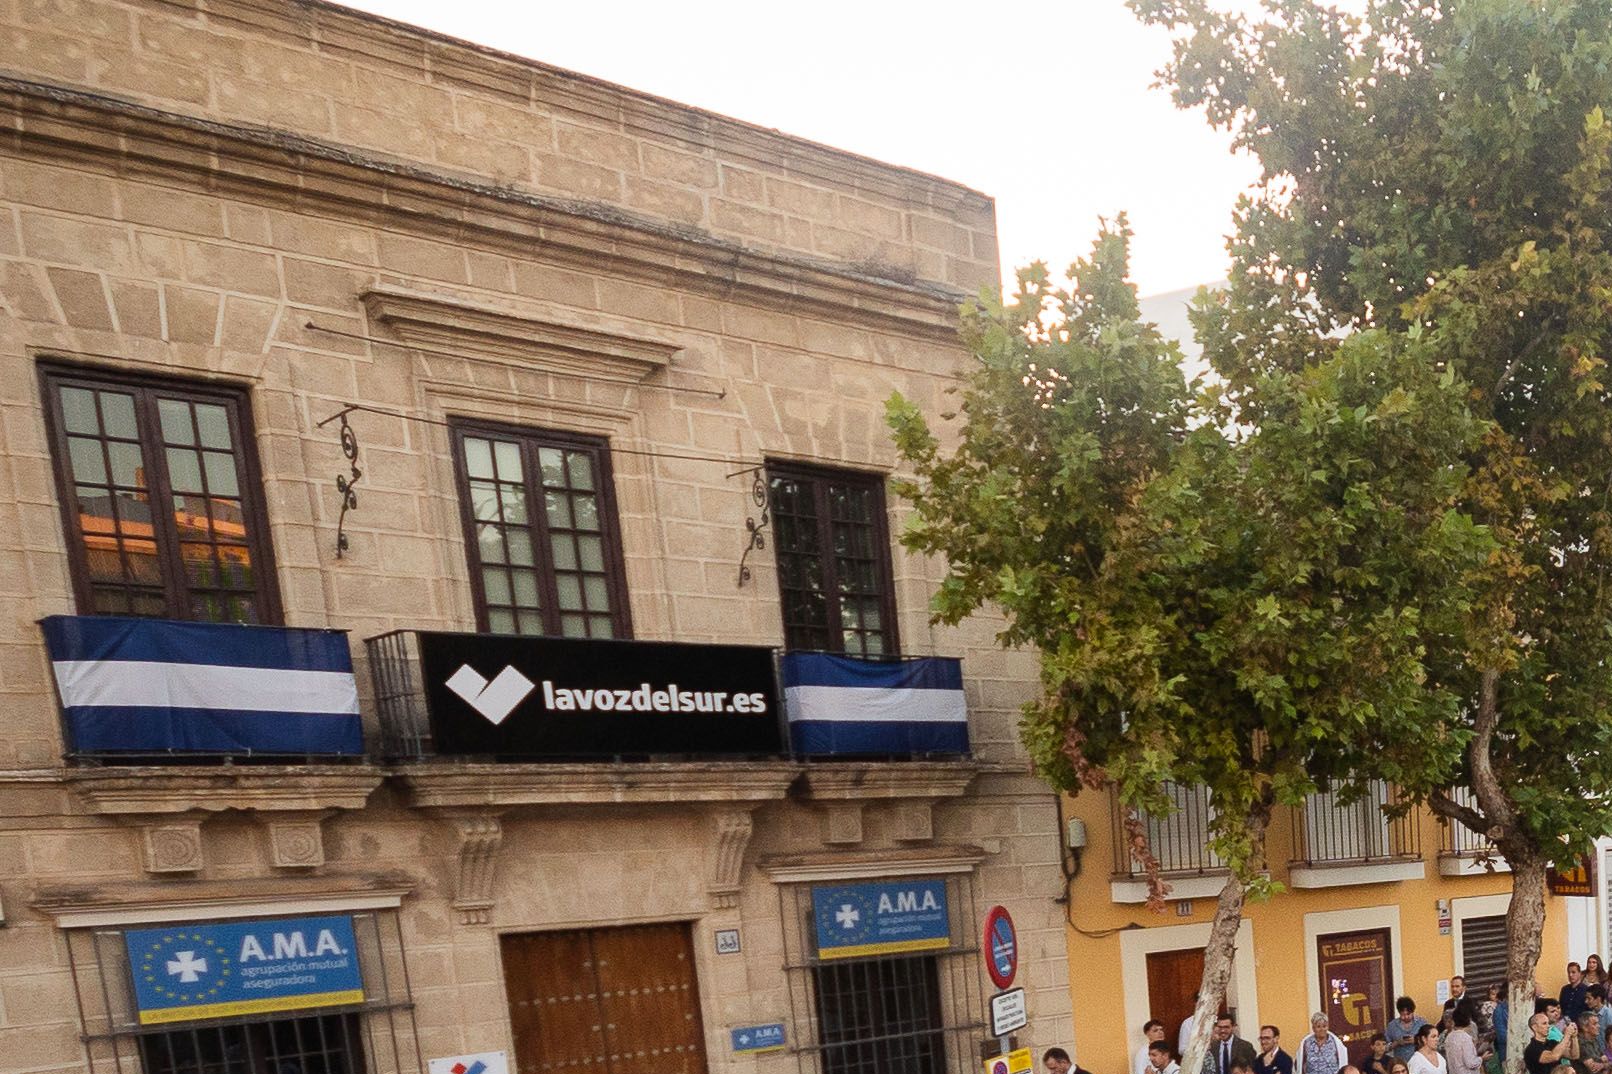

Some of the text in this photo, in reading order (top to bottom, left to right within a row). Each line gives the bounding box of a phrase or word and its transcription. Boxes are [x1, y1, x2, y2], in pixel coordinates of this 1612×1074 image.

[542, 680, 767, 713] lavozdelsur.es
[877, 889, 942, 914] A.M.A.
[239, 929, 349, 963] A.M.A.
[1335, 939, 1377, 953] TABACOS
[240, 957, 350, 979] agrupación mutual
[243, 974, 316, 990] aseguradora
